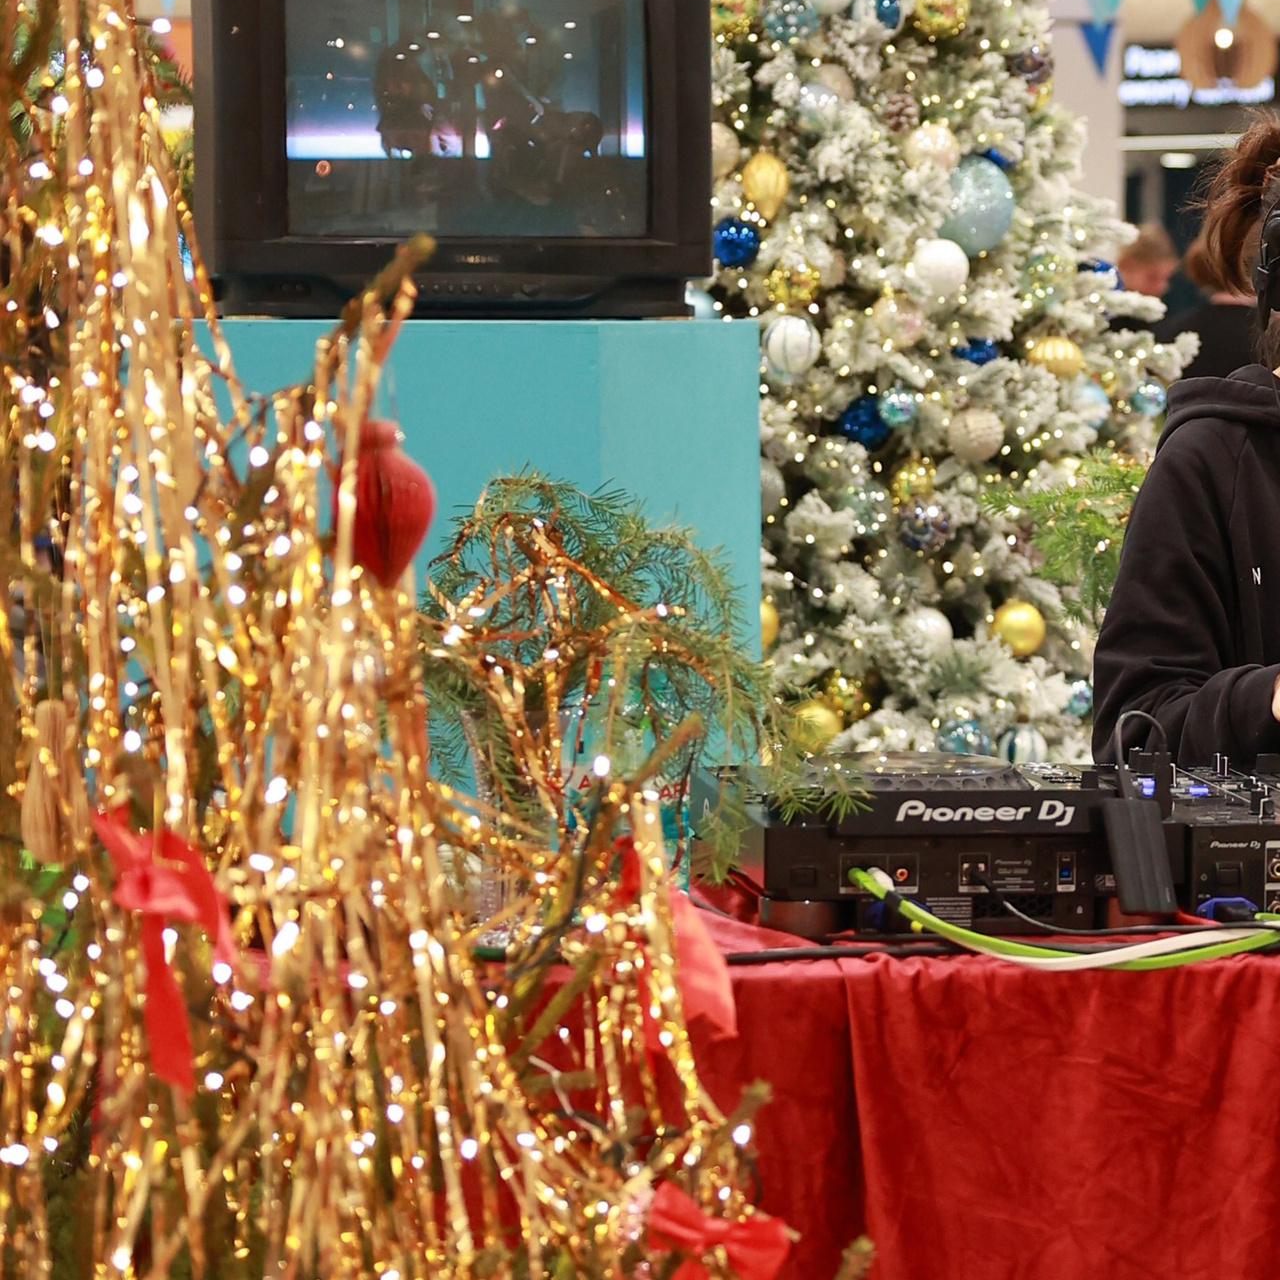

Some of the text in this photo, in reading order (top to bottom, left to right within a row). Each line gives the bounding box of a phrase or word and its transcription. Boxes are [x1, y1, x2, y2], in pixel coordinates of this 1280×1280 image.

[1251, 567, 1261, 585] N
[895, 799, 1031, 822] Pioneer
[1210, 840, 1248, 849] Pioneer
